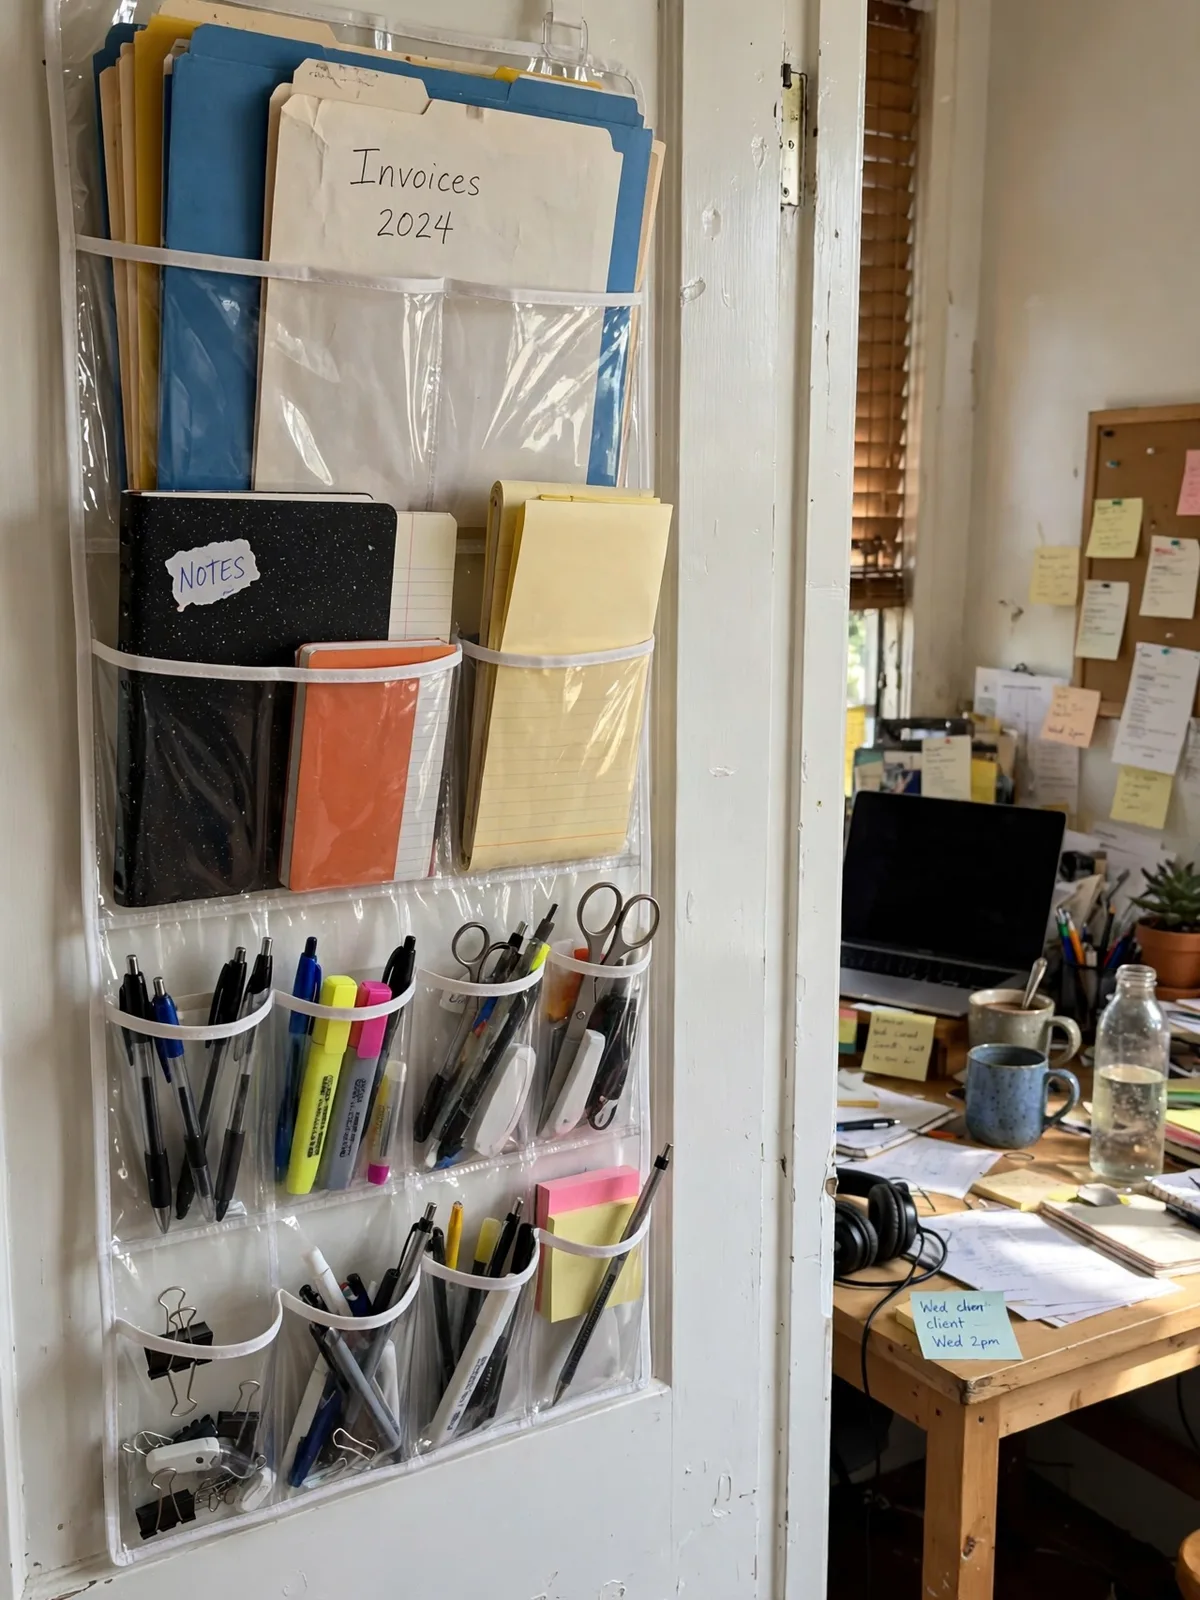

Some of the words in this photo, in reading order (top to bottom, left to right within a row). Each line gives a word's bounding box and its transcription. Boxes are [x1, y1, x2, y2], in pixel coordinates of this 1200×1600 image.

[350, 148, 480, 196] Invoices
[377, 208, 454, 244] 2024
[180, 556, 245, 593] NOTES
[920, 1299, 948, 1313] Wed
[926, 1316, 965, 1330] client
[932, 1334, 963, 1348] Wed
[970, 1335, 1000, 1351] 2pm
